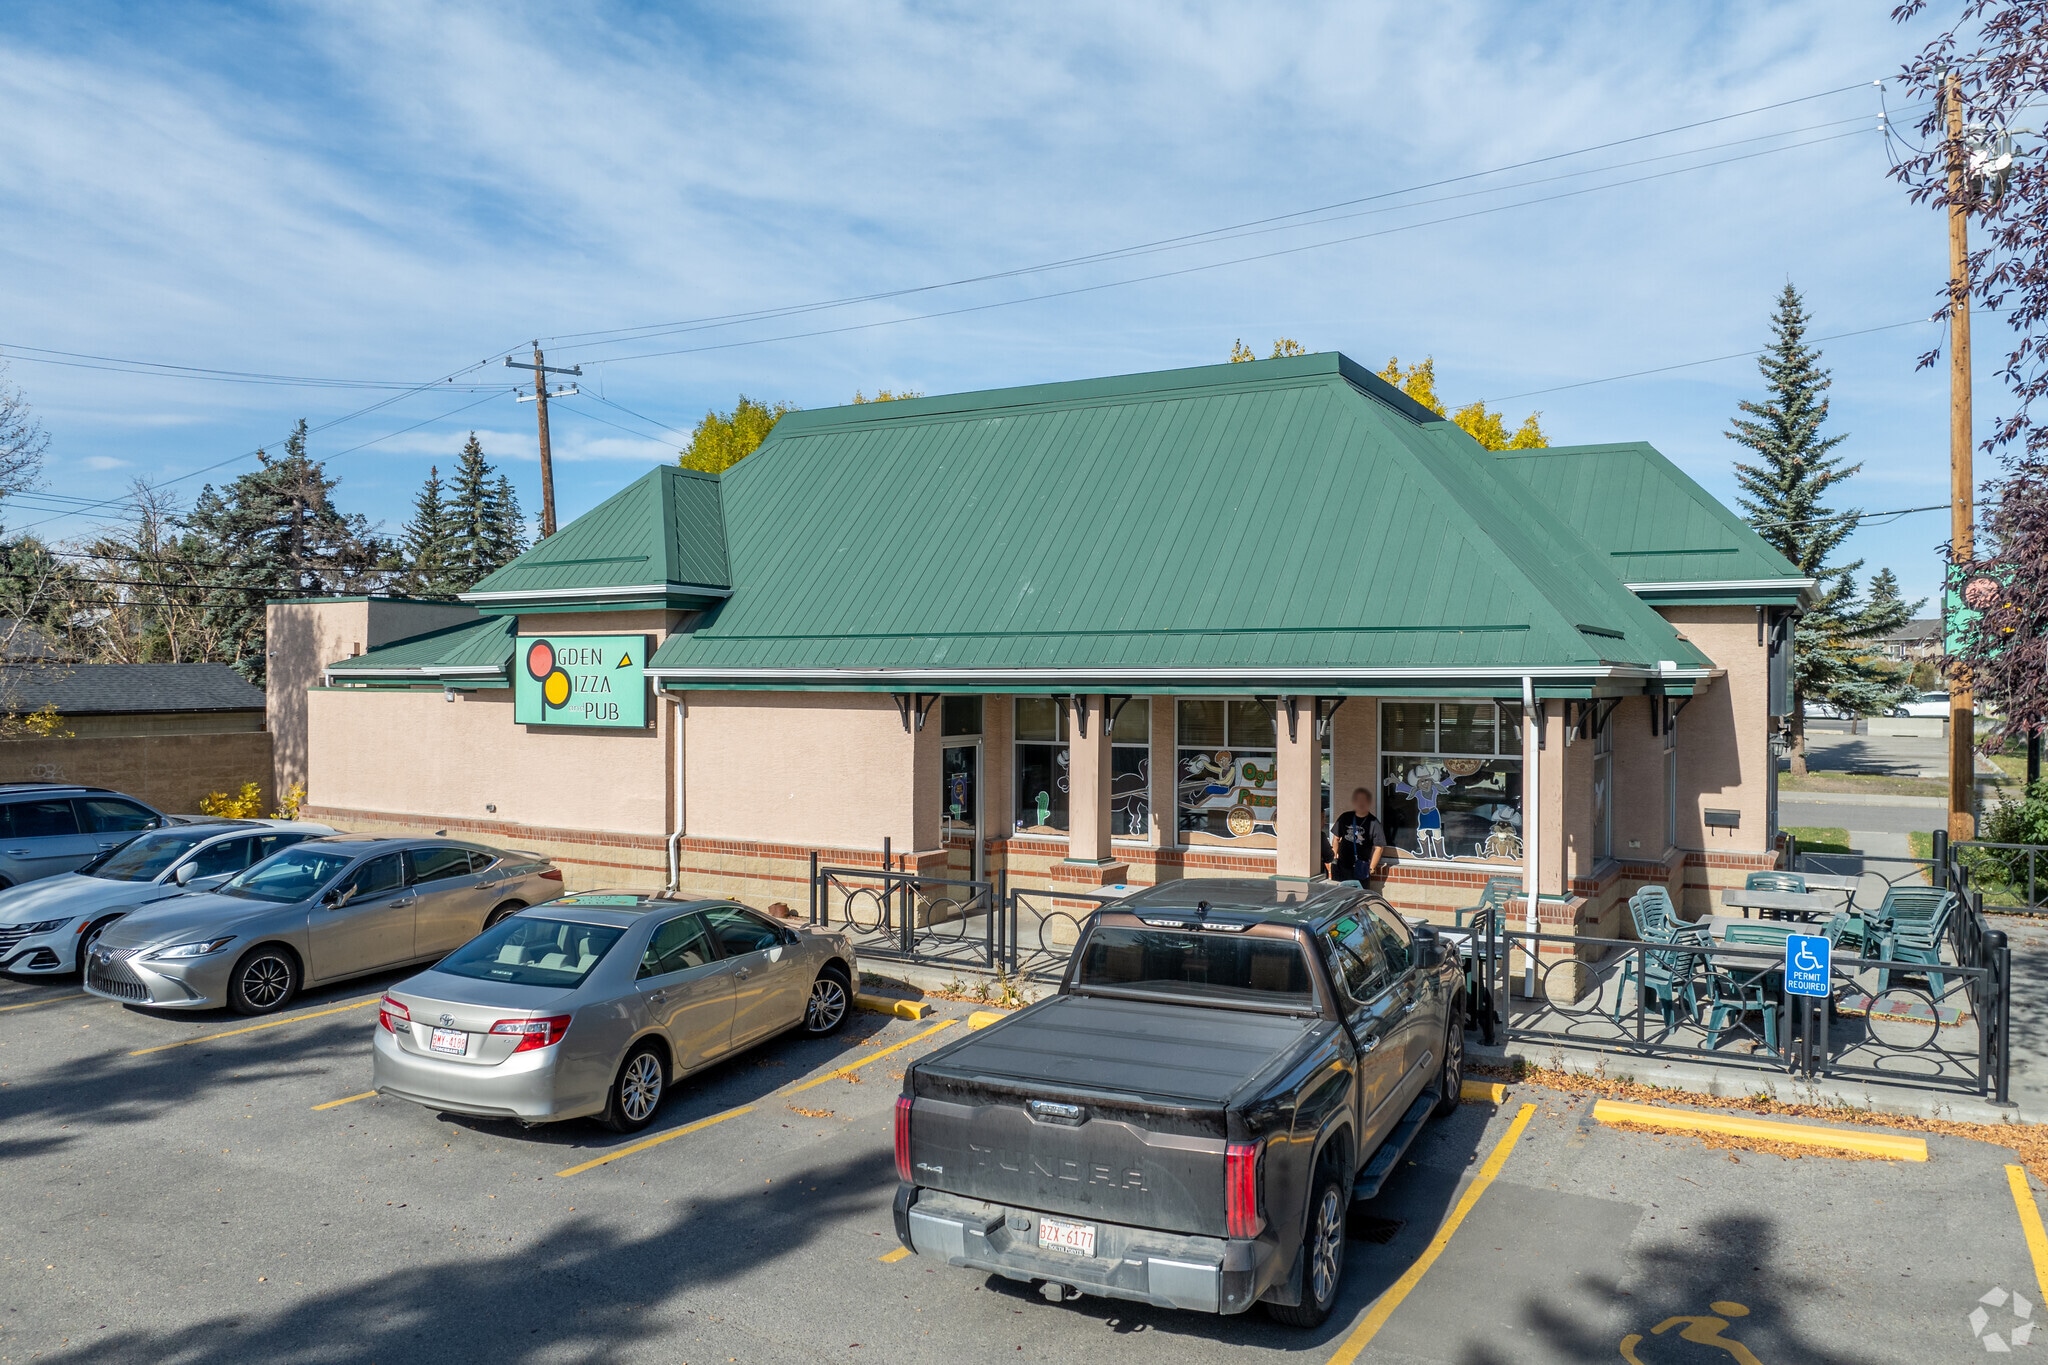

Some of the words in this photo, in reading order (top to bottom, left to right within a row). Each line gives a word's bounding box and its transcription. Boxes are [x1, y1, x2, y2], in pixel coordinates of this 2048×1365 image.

[568, 702, 585, 711] and
[585, 702, 620, 721] PUB
[1242, 762, 1277, 788] Ogd
[1788, 980, 1826, 992] REQUIRED
[1793, 971, 1821, 982] PERMIT
[969, 1143, 1149, 1192] TUNDRA
[1040, 1224, 1094, 1249] BZX-6177
